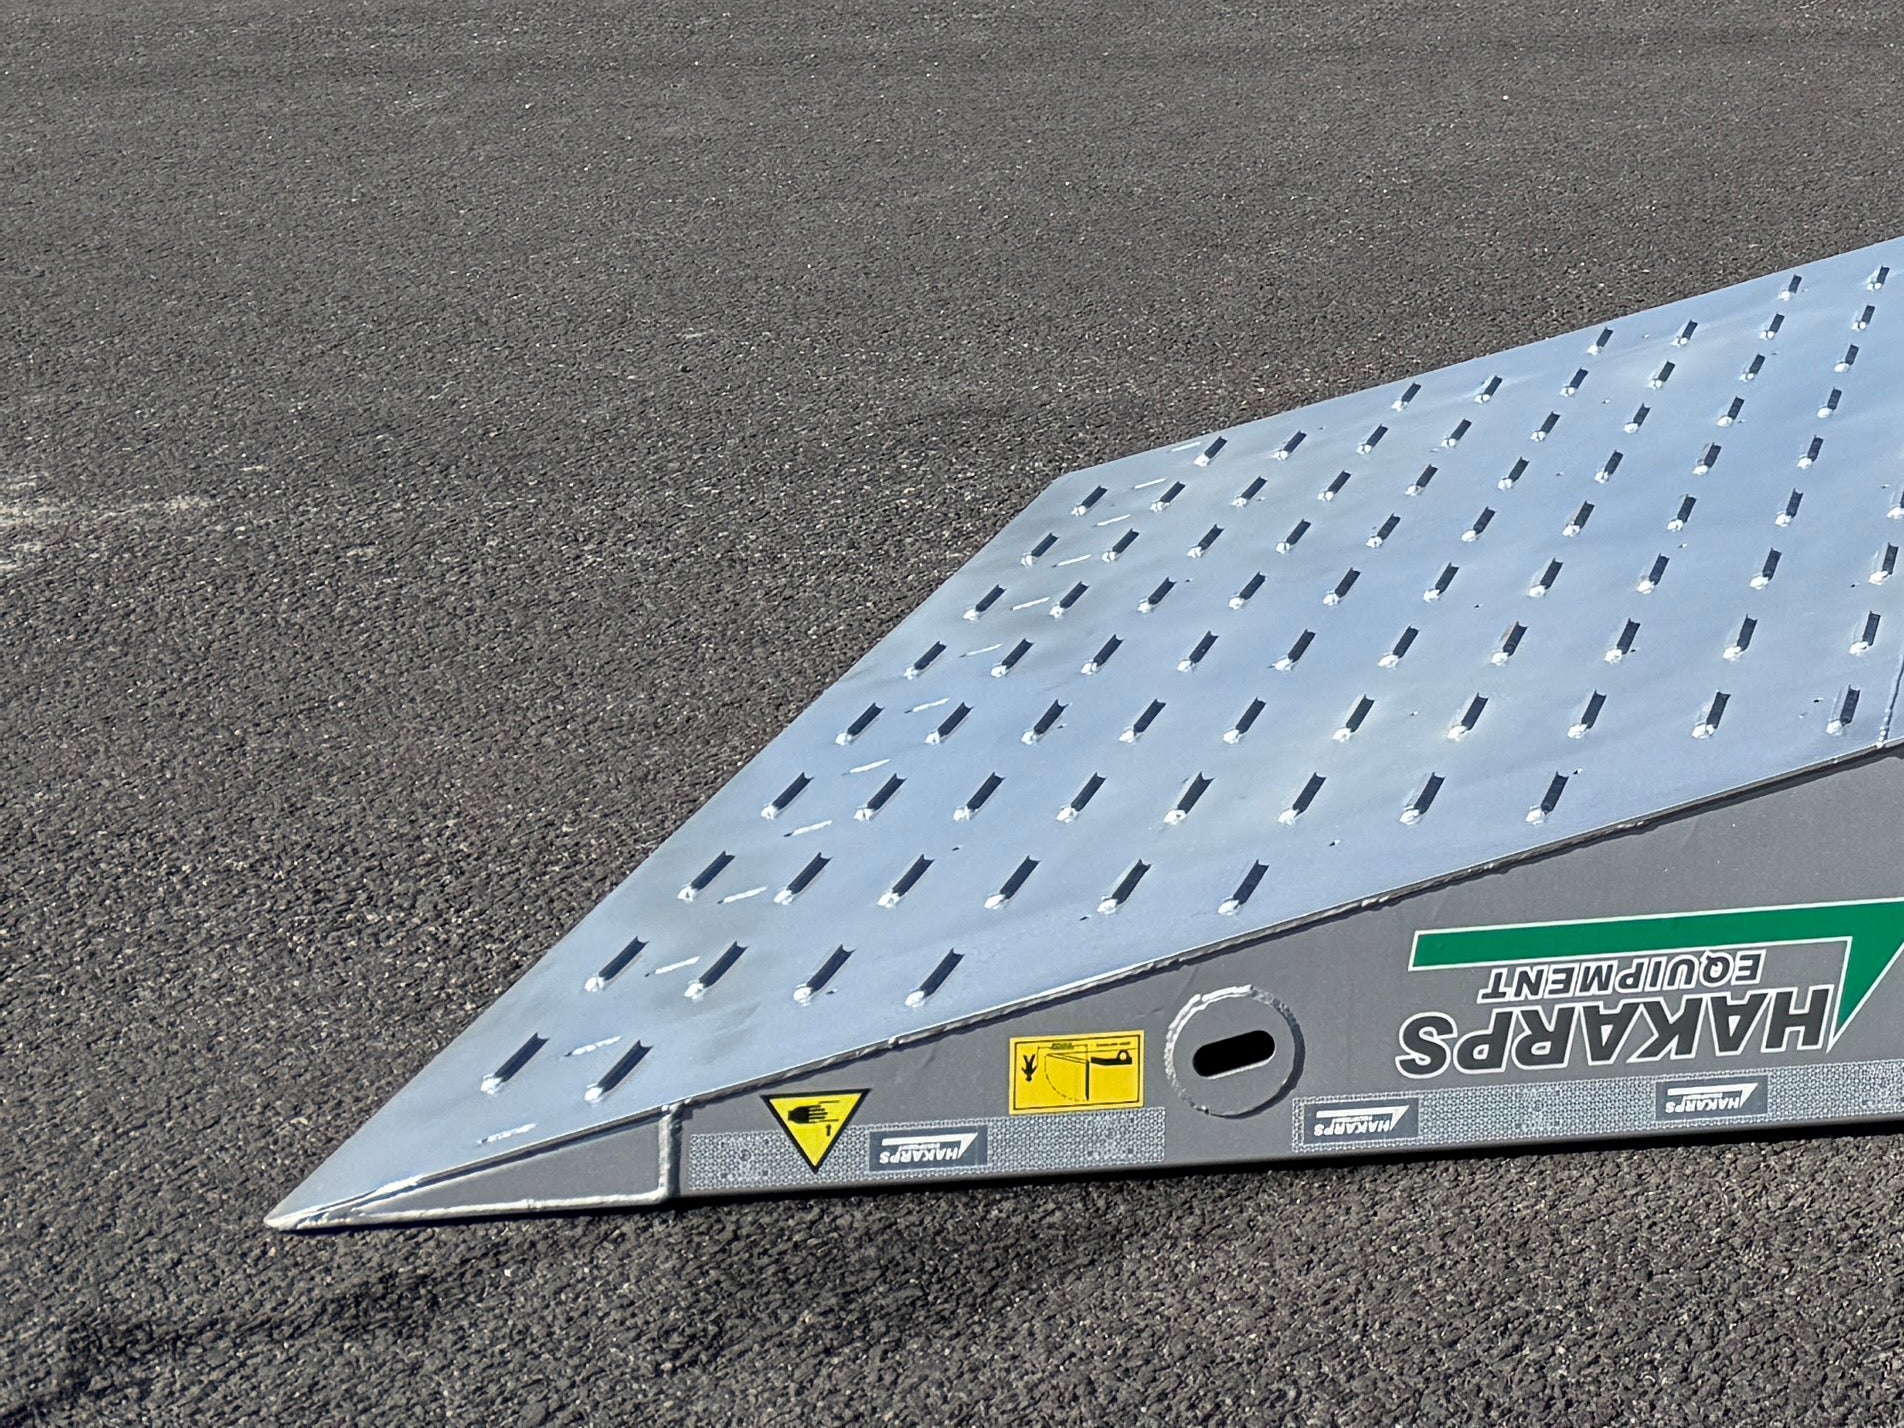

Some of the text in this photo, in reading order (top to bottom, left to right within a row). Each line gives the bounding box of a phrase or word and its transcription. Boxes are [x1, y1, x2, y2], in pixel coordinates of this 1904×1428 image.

[1477, 949, 1766, 1005] EQUIPMENT
[1395, 985, 1835, 1079] HAKARPS
[1664, 1096, 1741, 1114] HAKARPS
[1313, 1119, 1391, 1136] HAKARPS
[879, 1146, 961, 1164] HAKARPS
